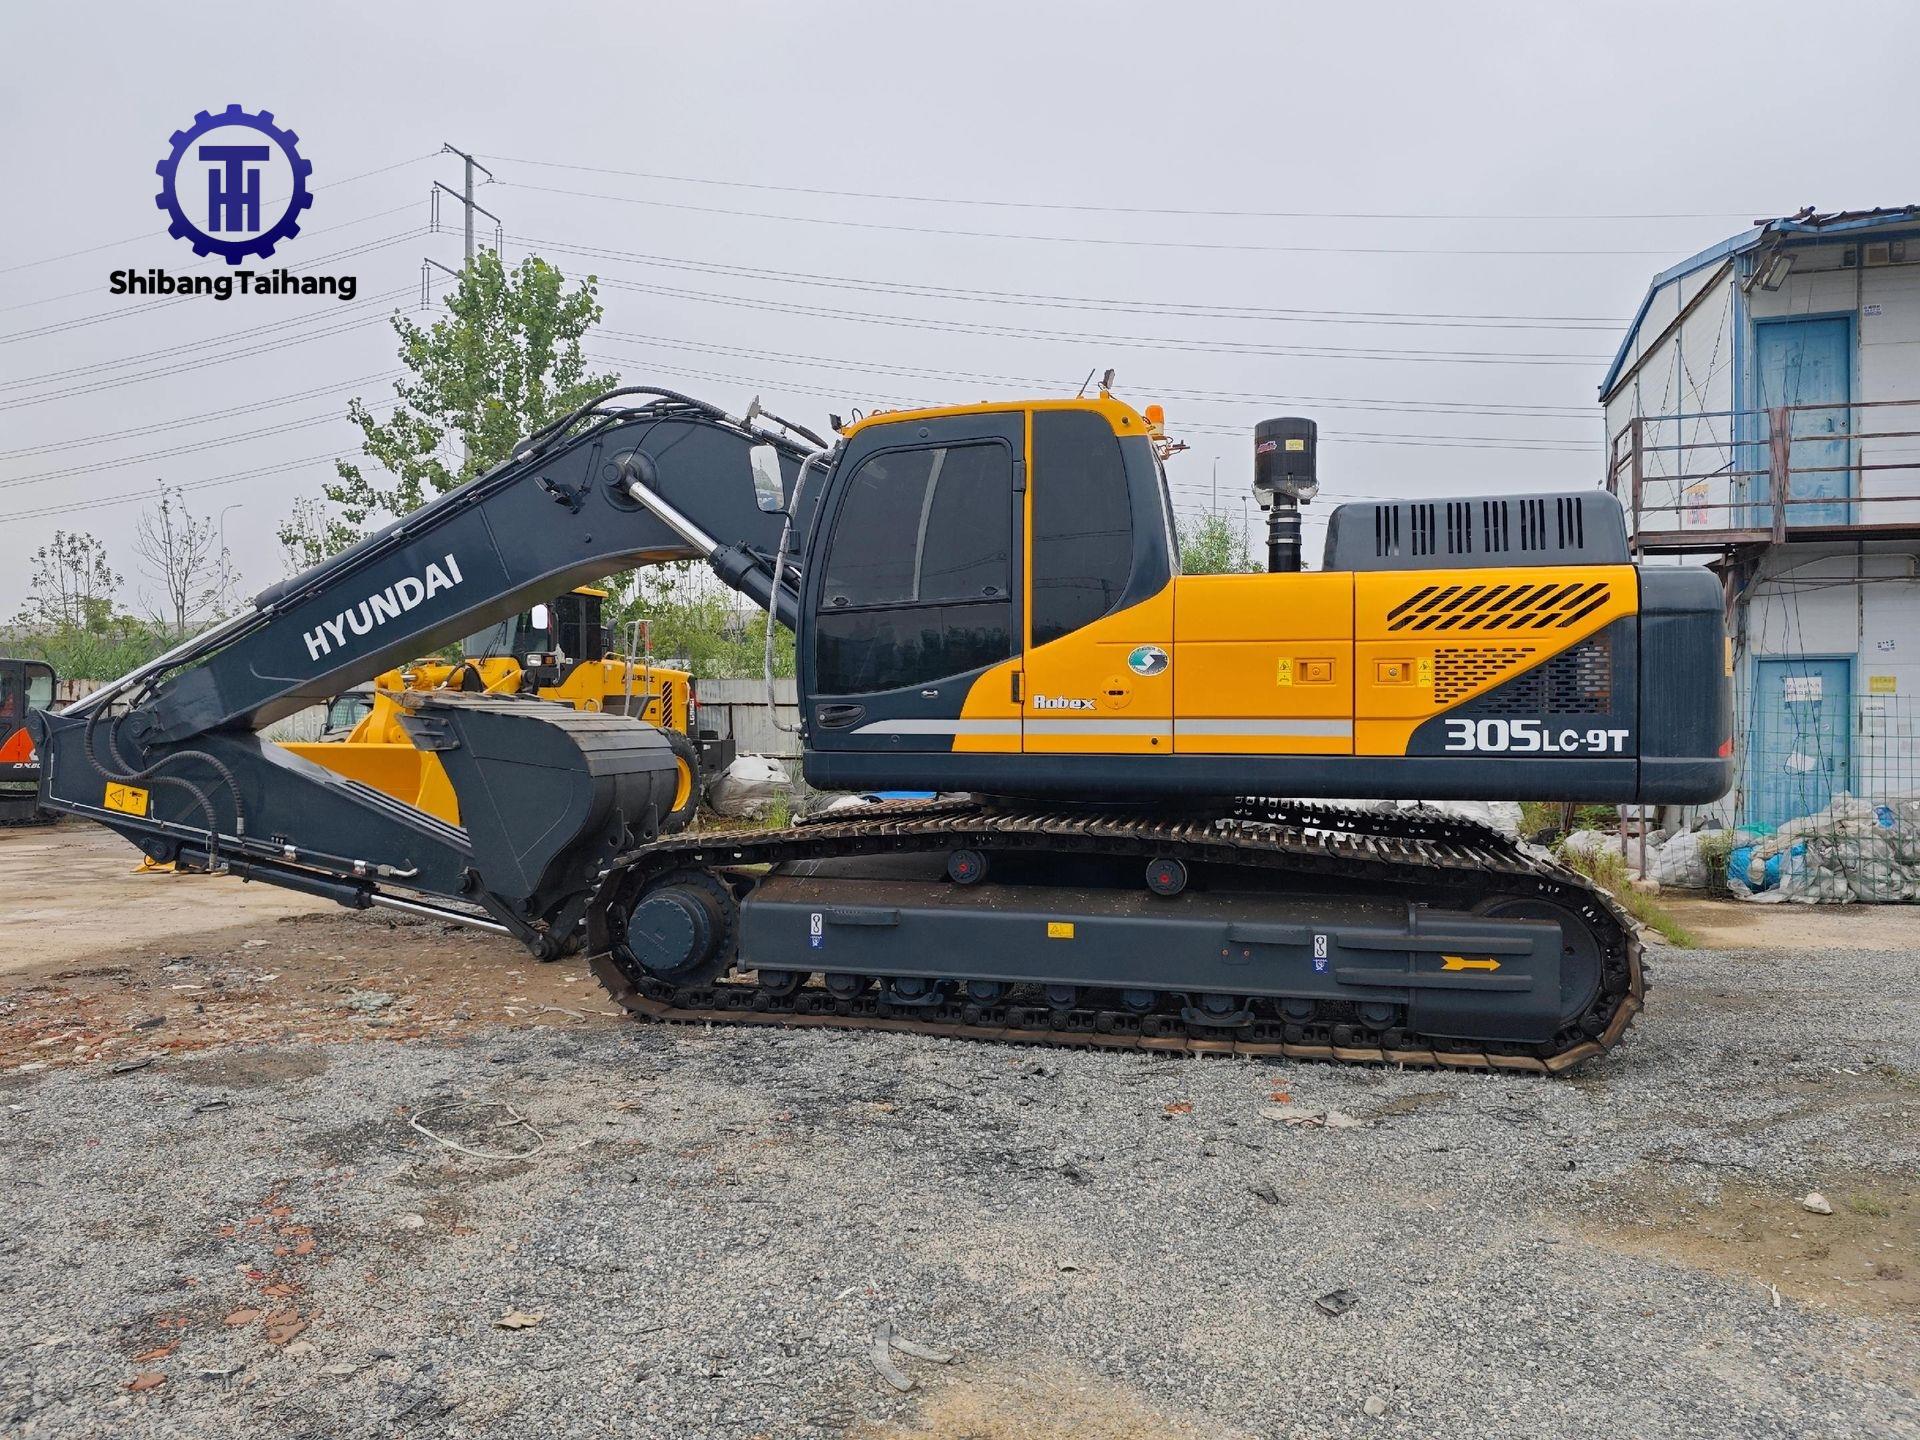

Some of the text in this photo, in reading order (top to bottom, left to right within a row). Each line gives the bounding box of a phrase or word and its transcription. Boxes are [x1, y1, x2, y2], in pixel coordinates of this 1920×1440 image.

[303, 553, 464, 662] HYUNDAI
[1033, 694, 1097, 710] Robex
[1445, 719, 1630, 752] 305LC-9T
